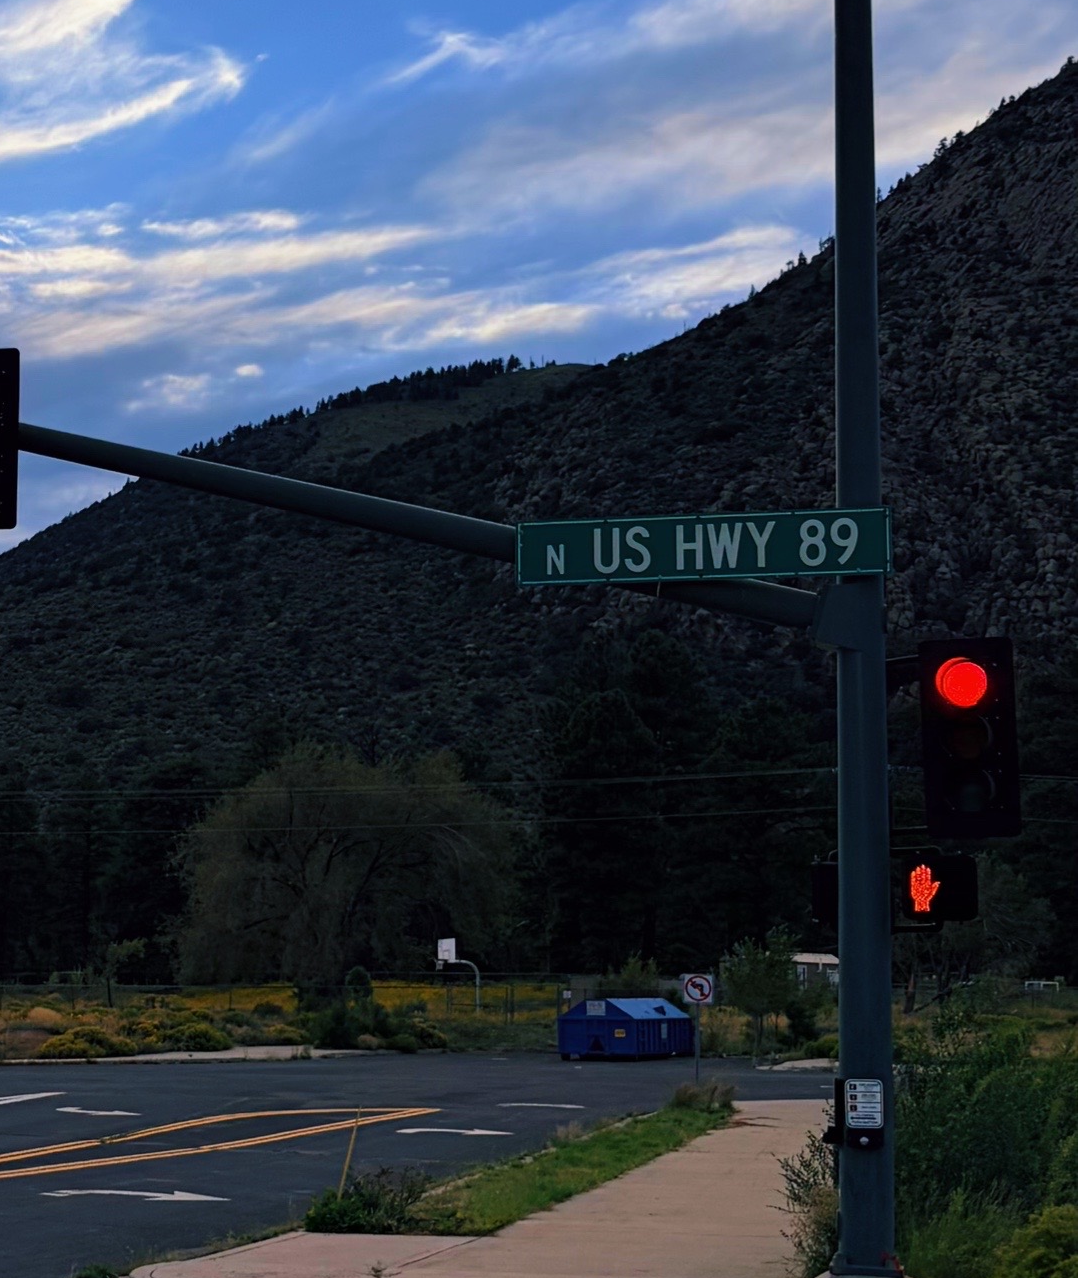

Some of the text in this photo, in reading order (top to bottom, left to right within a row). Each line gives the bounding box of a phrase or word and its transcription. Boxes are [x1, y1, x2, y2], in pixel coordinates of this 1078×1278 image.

[546, 517, 859, 575] N US HWY 89
